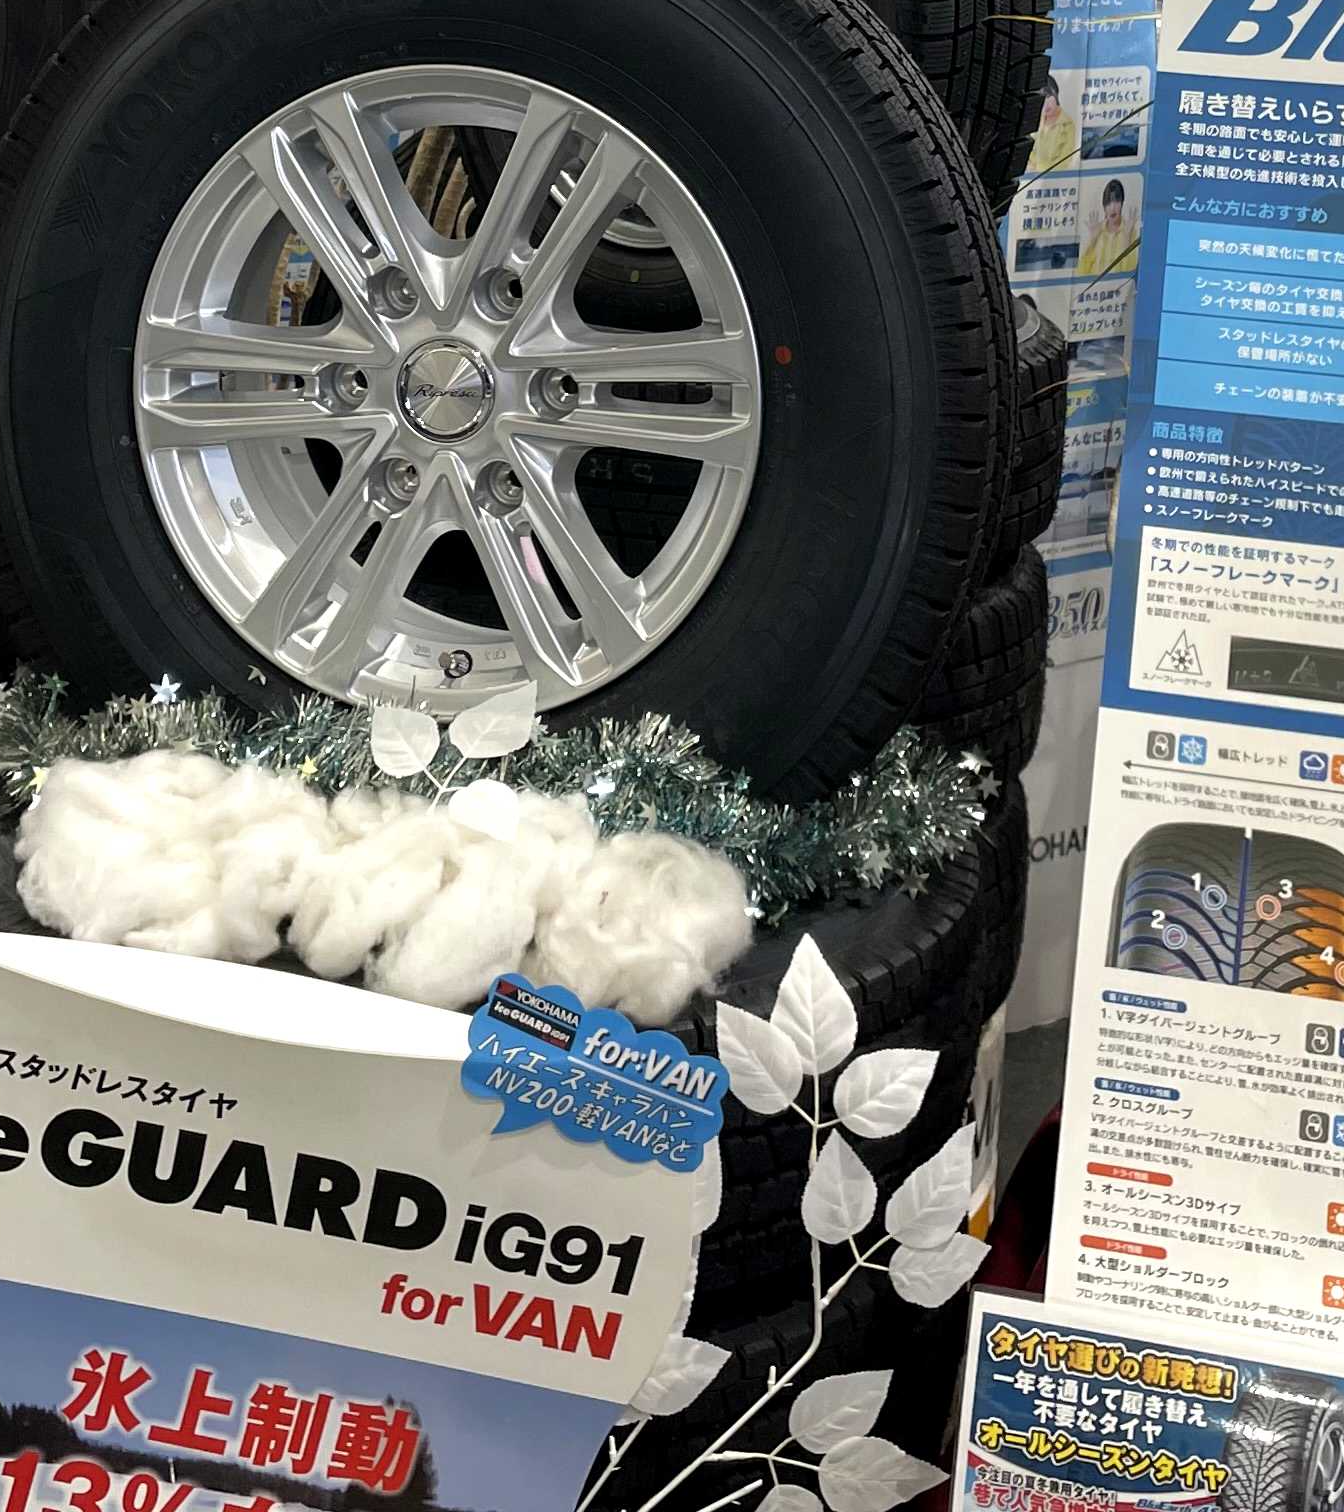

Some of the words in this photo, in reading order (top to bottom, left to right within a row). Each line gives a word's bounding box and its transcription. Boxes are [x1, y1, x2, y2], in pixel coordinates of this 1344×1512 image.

[1171, 195, 1328, 225] こんな方におすすめ
[1155, 503, 1275, 529] スノーフレークマーク
[1150, 536, 1336, 570] 冬期での性能を証明するマーク
[1149, 556, 1340, 594] 「スノーフレークマーク」
[1191, 873, 1202, 891] 1
[1278, 878, 1294, 899] 3
[1150, 909, 1166, 930] 2
[1319, 945, 1335, 966] 4
[515, 988, 581, 1027] YOKOHAMA
[453, 1202, 646, 1296] iG91
[380, 1272, 462, 1328] for
[469, 1282, 624, 1361] VAN
[989, 1324, 1238, 1400] タイヤ選びの新発想!
[992, 1369, 1208, 1429] 一年を通して履き替え
[60, 1344, 423, 1494] 氷上制動
[1033, 1399, 1163, 1445] 不要なタイヤ
[976, 1420, 1232, 1494] オールシーズンタイヤ
